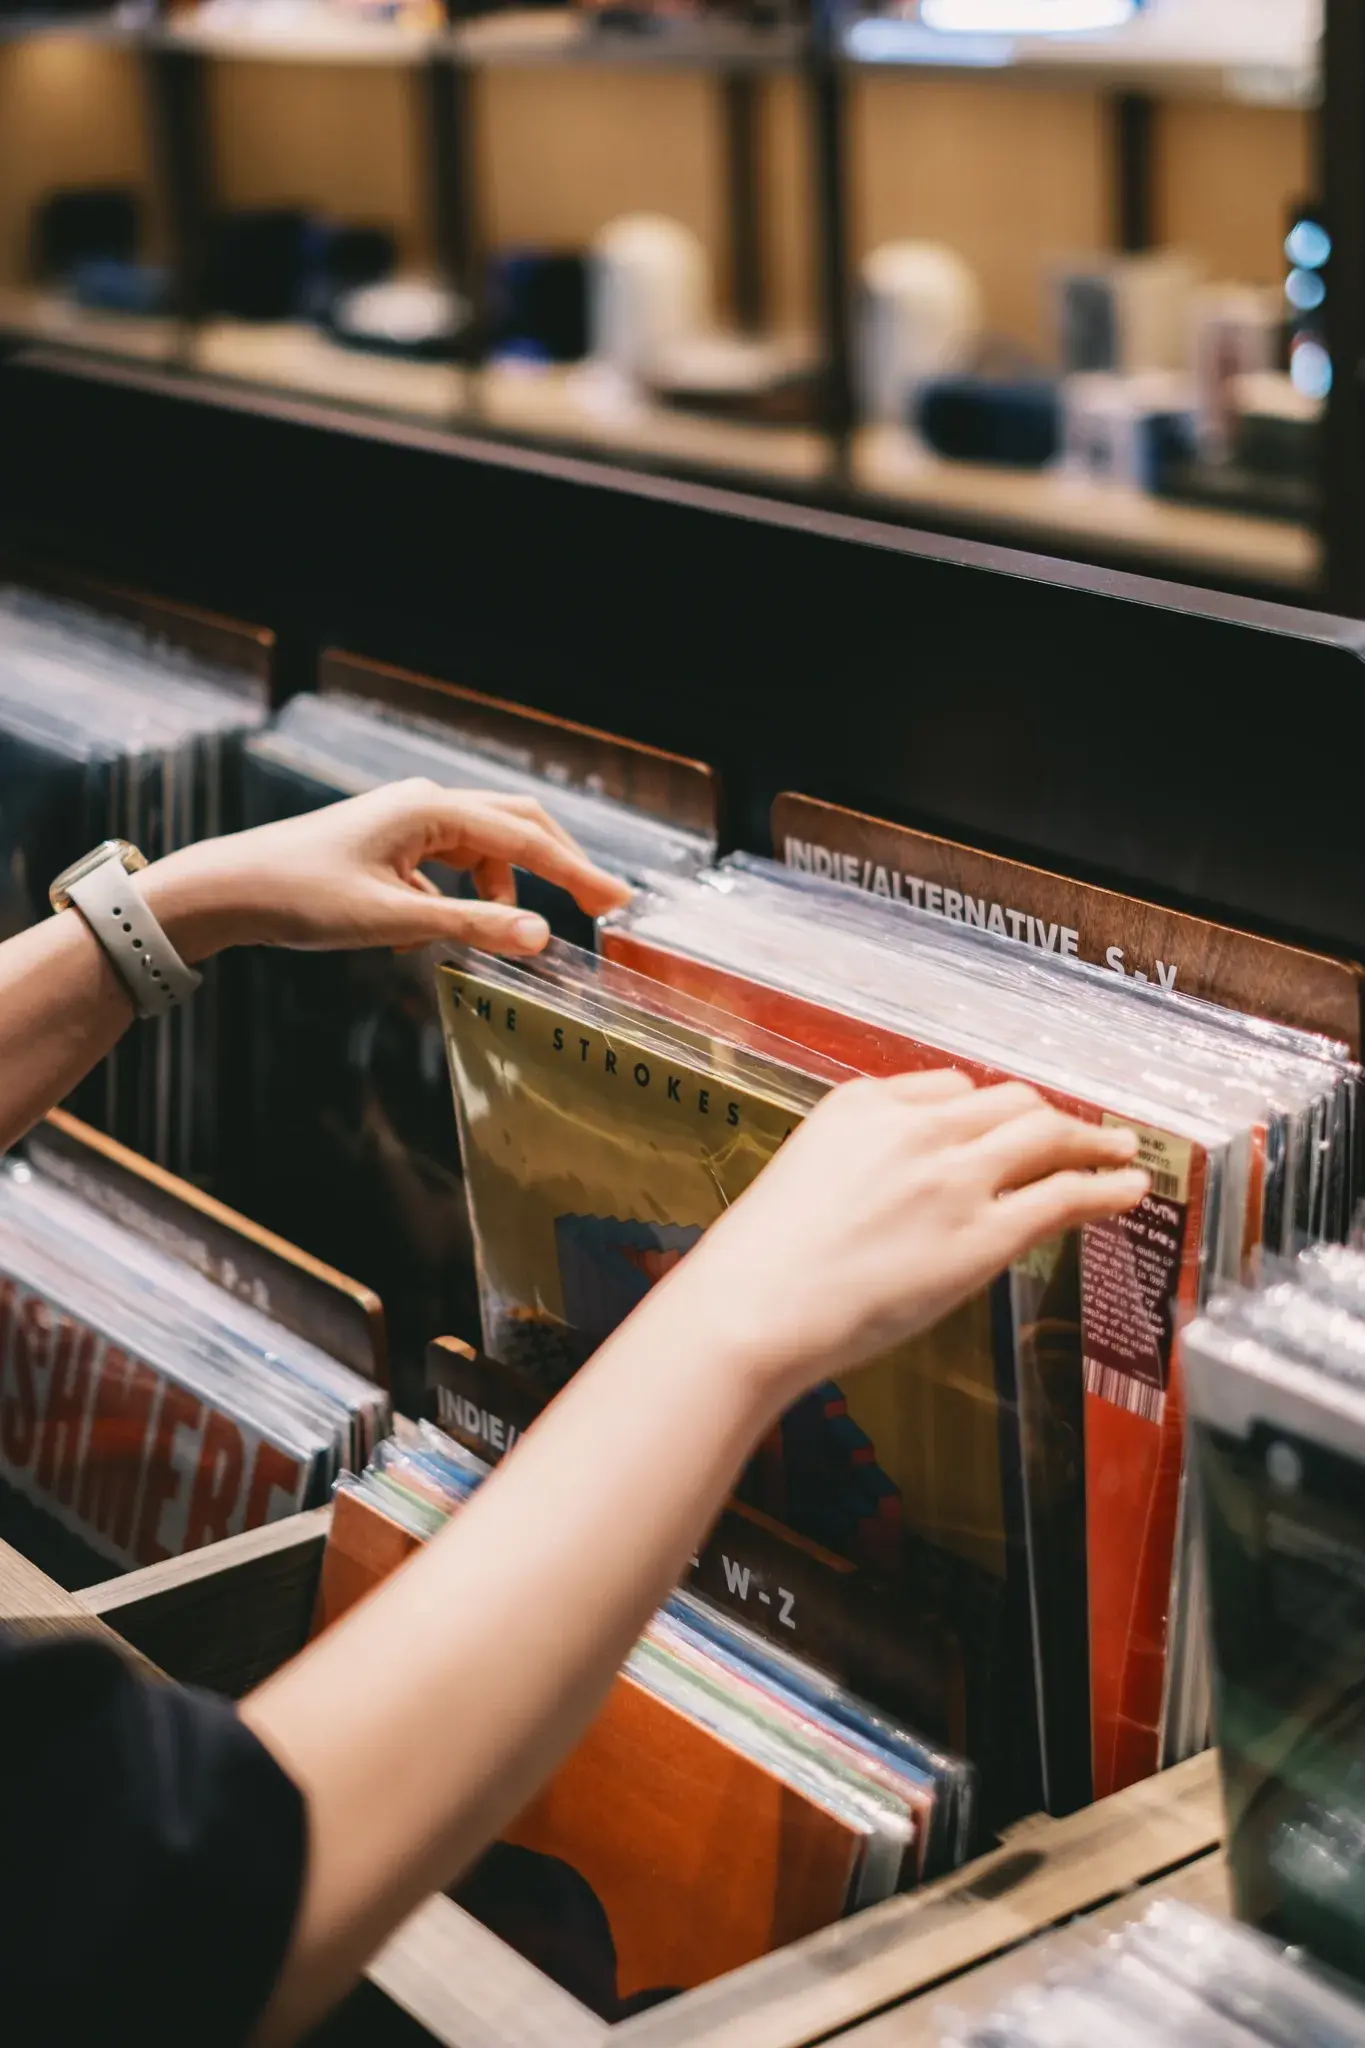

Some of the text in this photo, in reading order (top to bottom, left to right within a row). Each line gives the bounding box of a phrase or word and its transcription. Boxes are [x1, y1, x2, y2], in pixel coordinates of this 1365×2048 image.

[784, 836, 1079, 960] INDIE/ALTERNATIVE
[452, 984, 740, 1127] THE STROKES
[1140, 1196, 1178, 1226] OUTH
[437, 1384, 522, 1453] INDIE/
